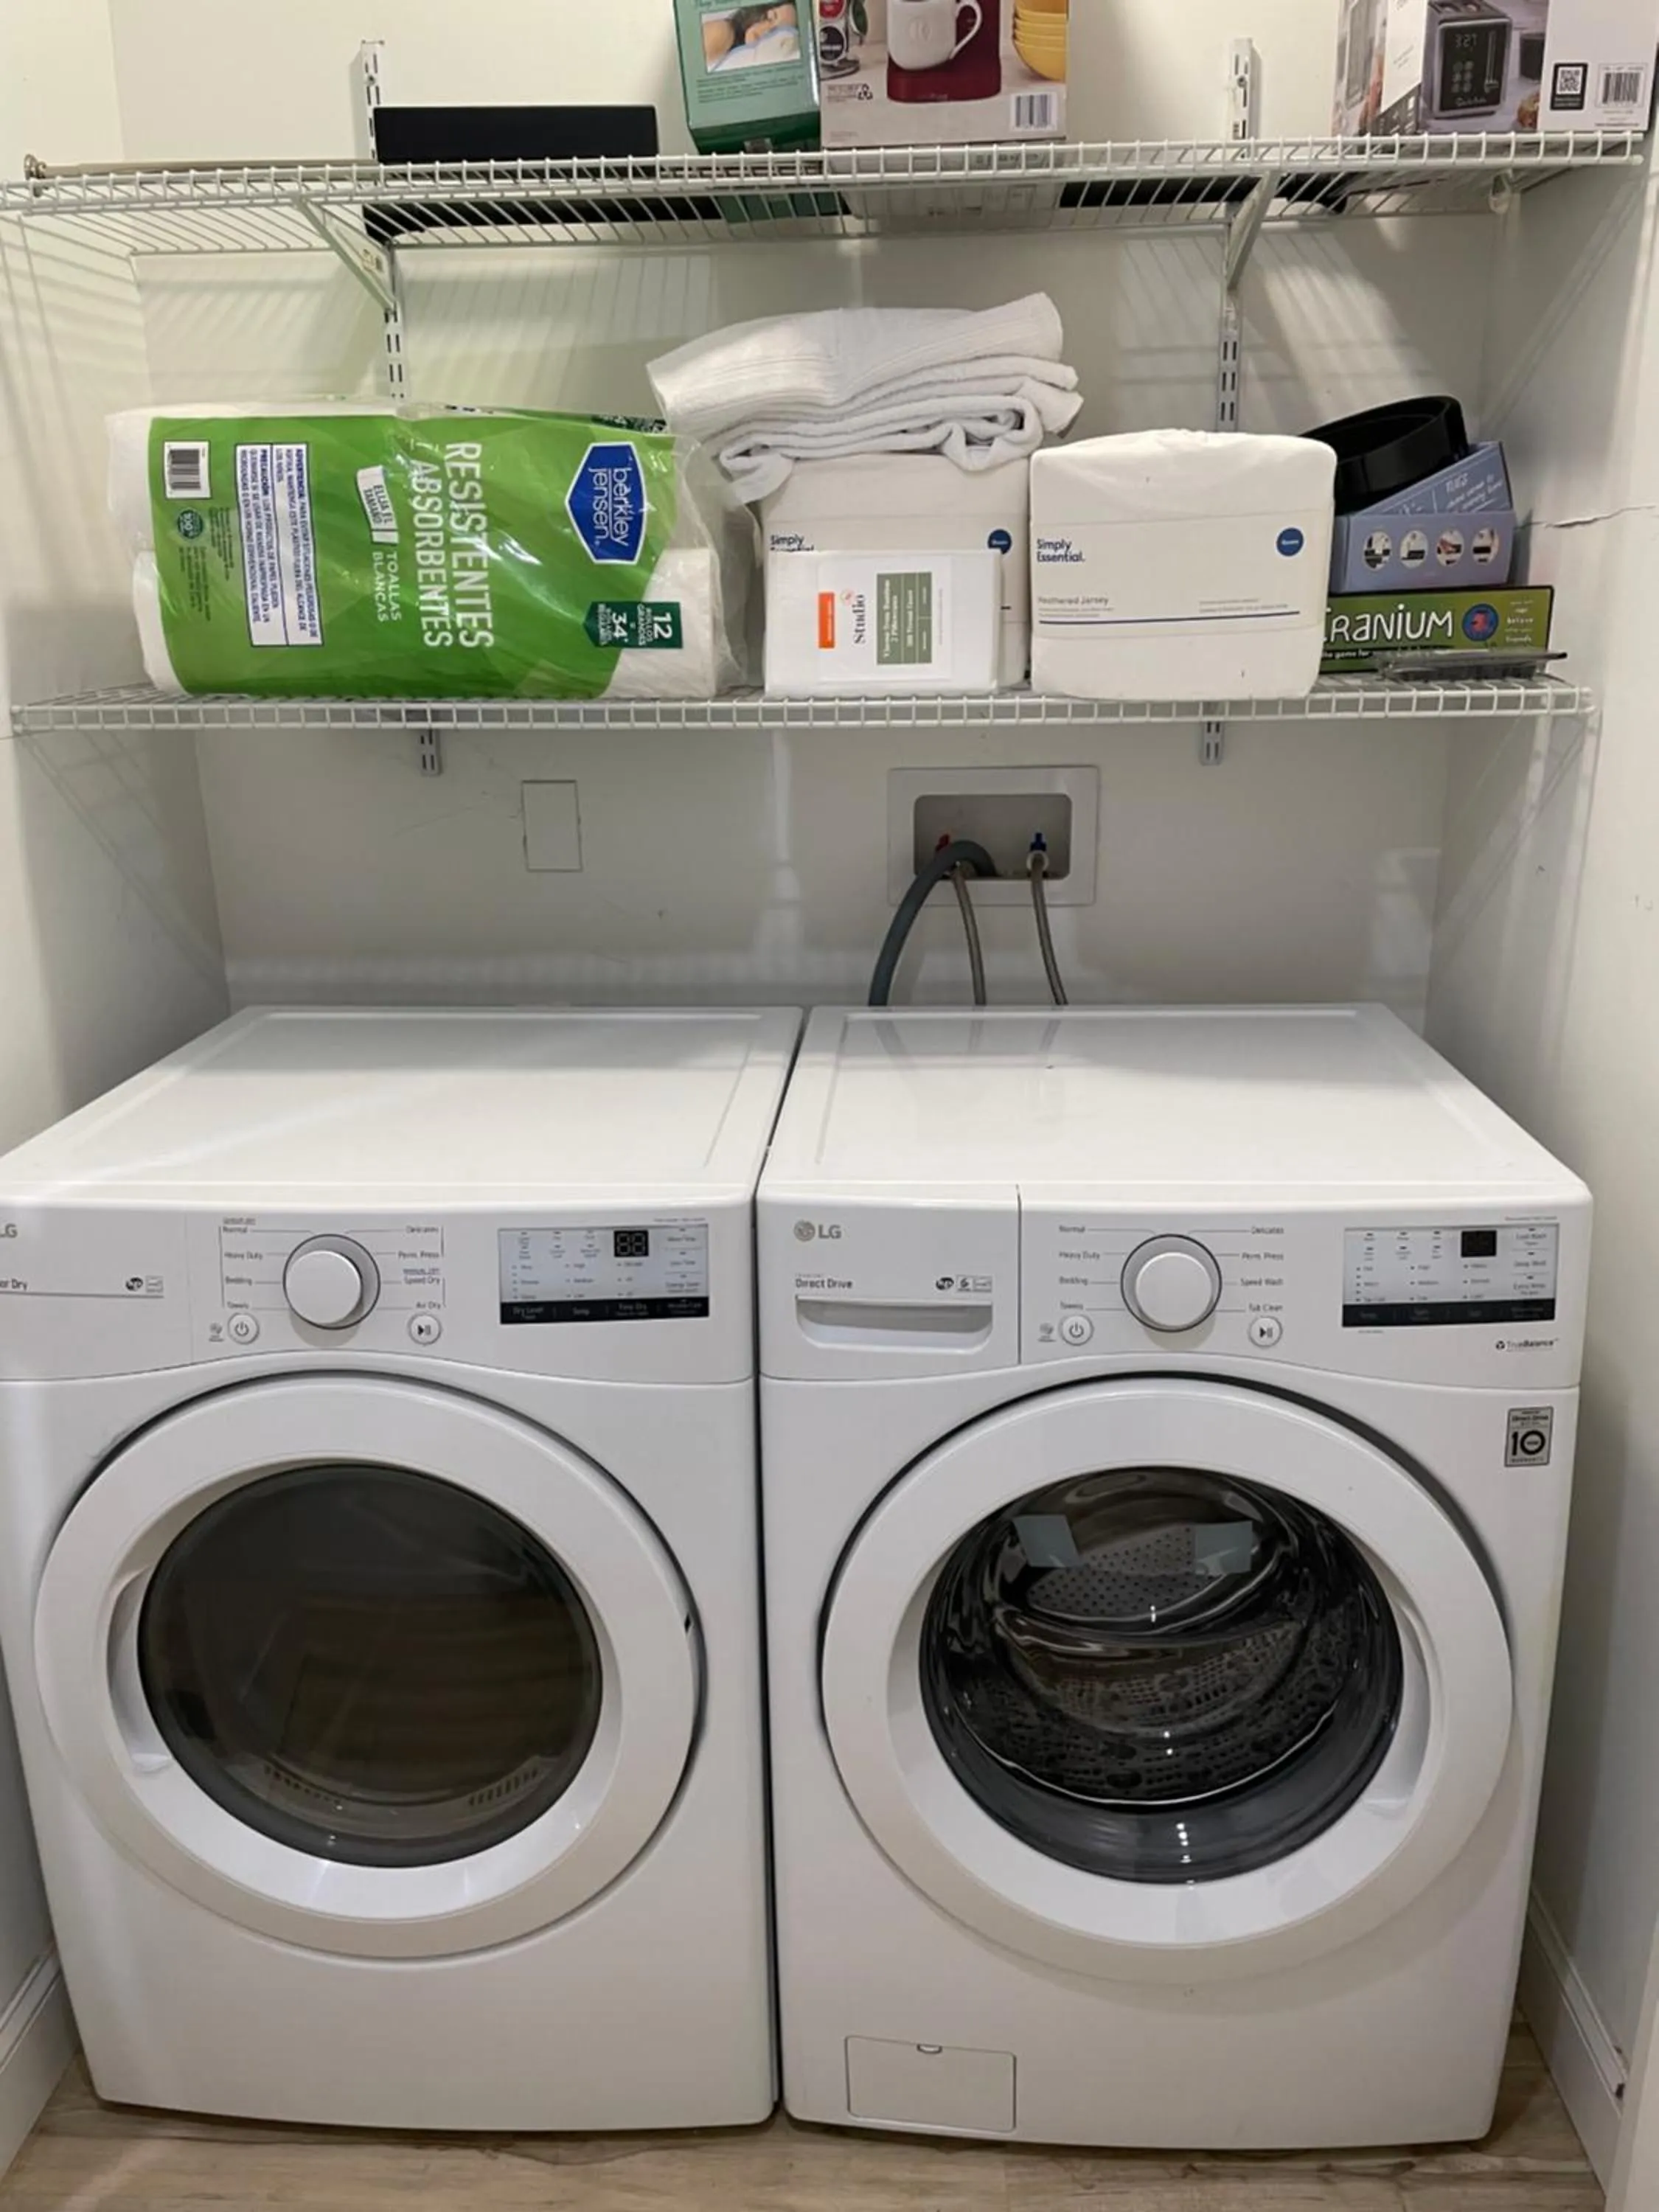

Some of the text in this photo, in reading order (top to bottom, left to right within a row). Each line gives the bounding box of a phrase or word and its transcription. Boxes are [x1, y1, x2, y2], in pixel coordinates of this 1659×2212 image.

[611, 467, 633, 546] berkley
[408, 460, 452, 647] ABSORBENTES
[445, 443, 494, 647] RESISTENTES
[771, 533, 804, 550] Simply
[1037, 538, 1072, 552] Simply
[372, 551, 389, 622] BLANCAS
[386, 551, 401, 621] TOALLAS
[653, 612, 672, 639] 12
[853, 594, 865, 644] Studio
[818, 1224, 842, 1239] LG
[11, 1279, 28, 1292] Dry
[796, 1278, 853, 1290] Direct Drive
[1511, 1430, 1546, 1456] 10
